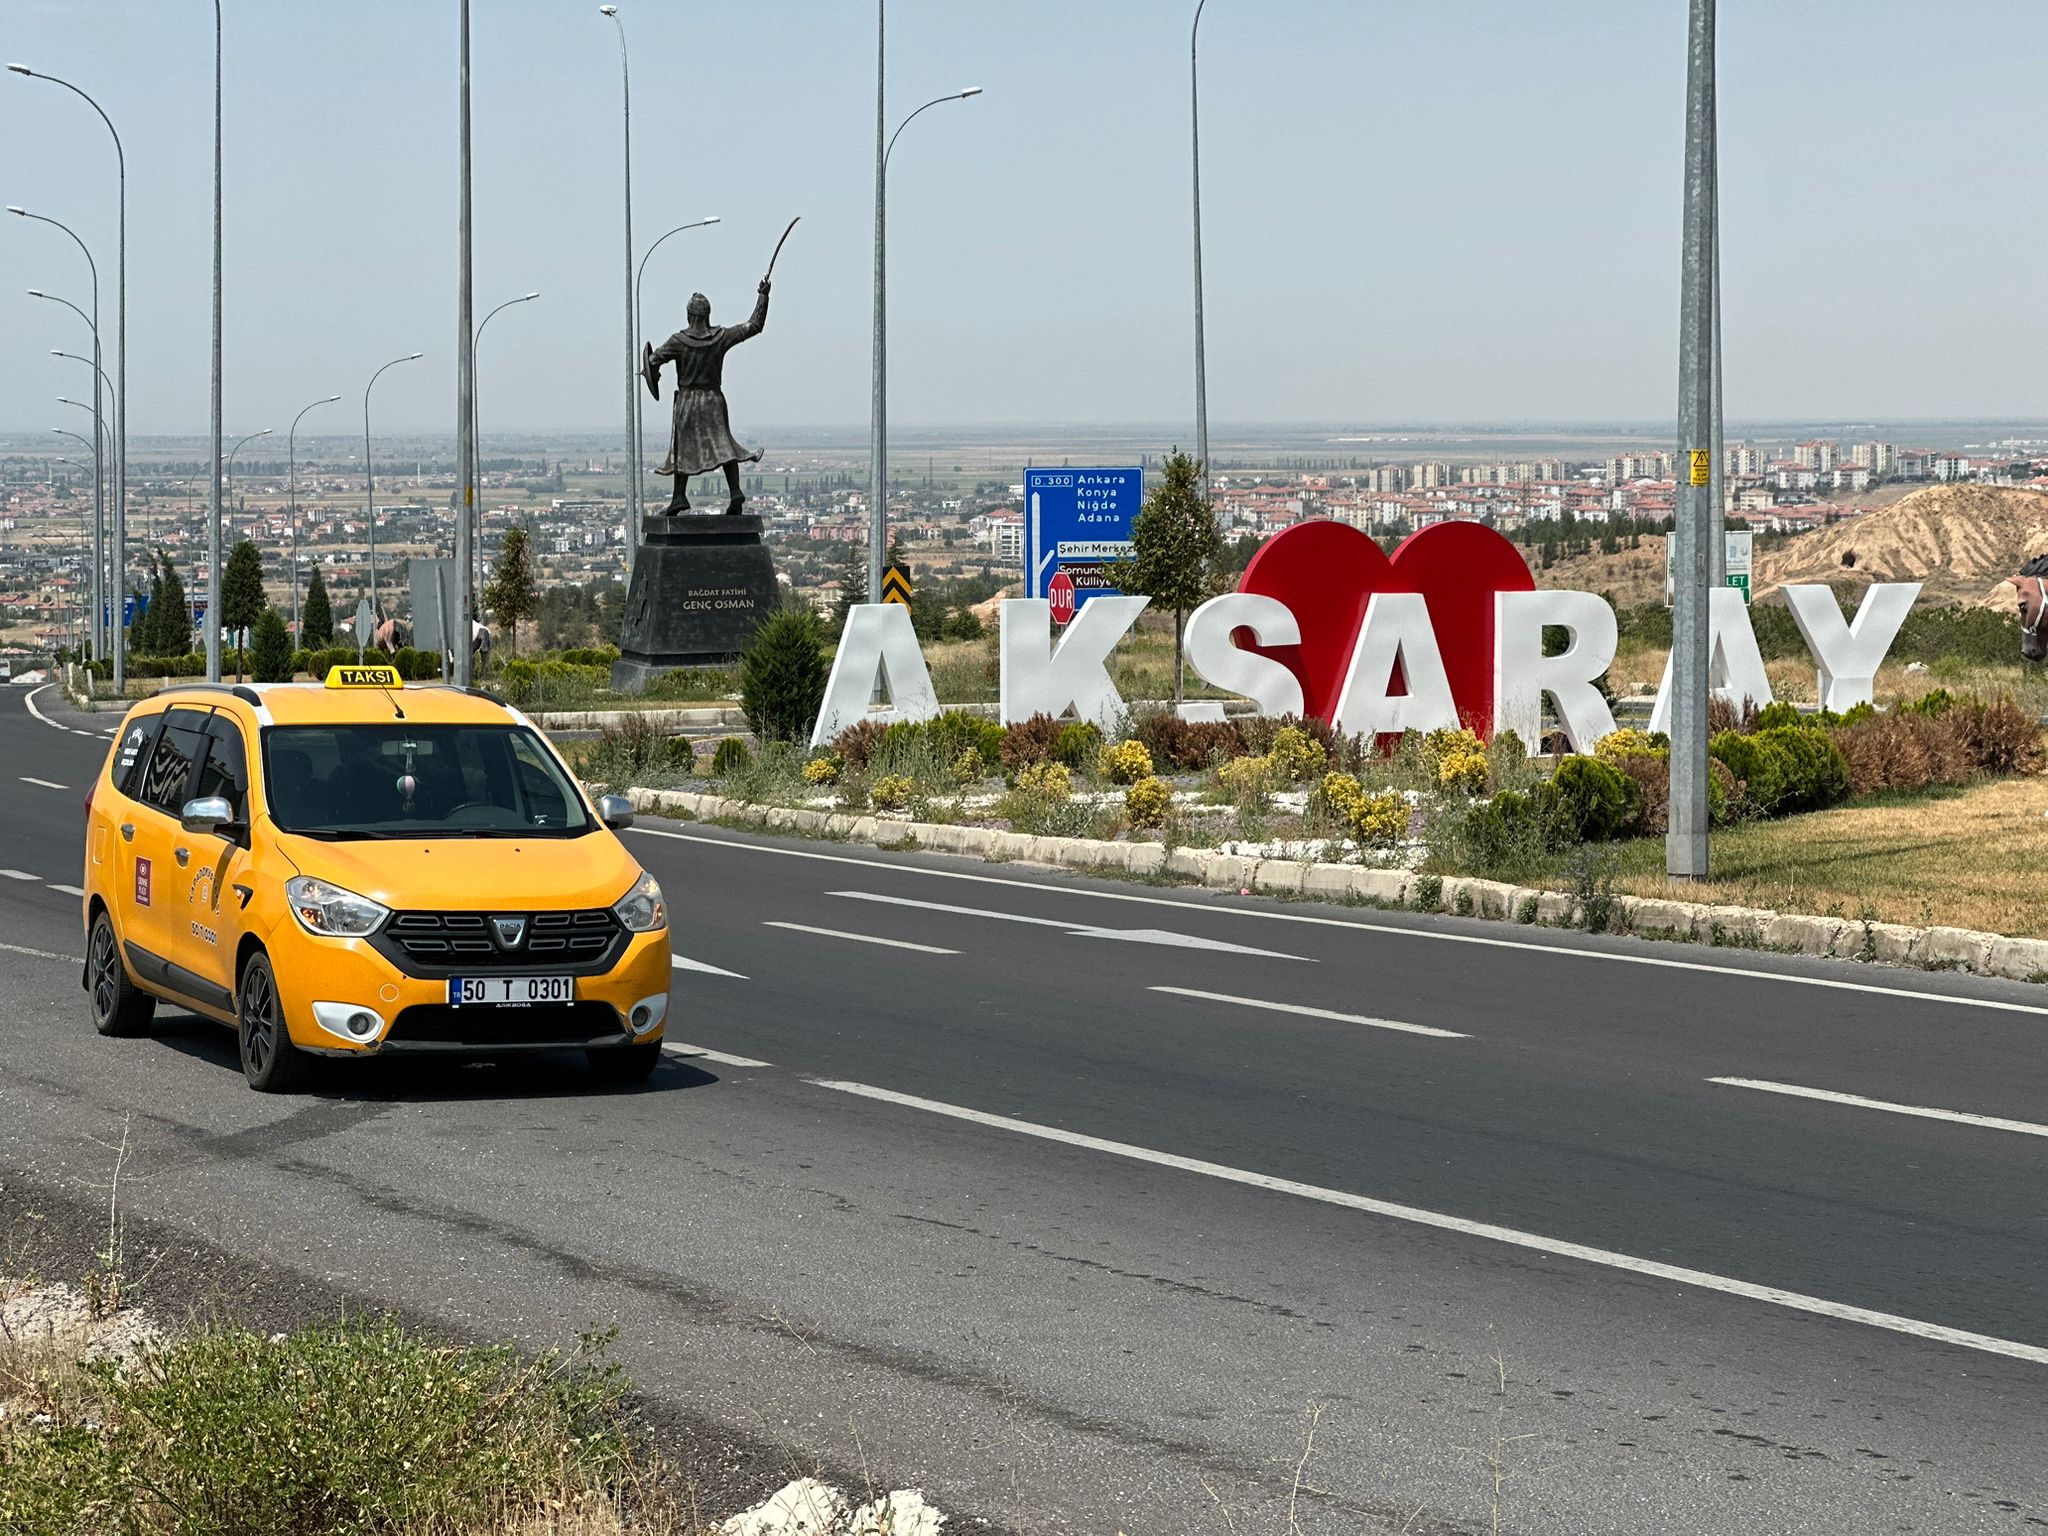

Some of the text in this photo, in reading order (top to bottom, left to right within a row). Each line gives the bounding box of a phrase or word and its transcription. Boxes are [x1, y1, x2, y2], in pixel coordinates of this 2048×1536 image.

[1078, 474, 1125, 484] Ankara
[1077, 487, 1117, 499] Konya
[1077, 500, 1117, 512] Niğde
[1078, 512, 1120, 523] Adana
[1059, 543, 1089, 554] Şehir
[1726, 575, 1745, 586] LET
[688, 586, 747, 597] BAĞDAT FATİHİ
[1050, 588, 1073, 608] DUR
[683, 599, 755, 611] GENÇ OSMAN
[810, 583, 1923, 757] AKSARAY
[463, 979, 485, 1001] 50
[502, 979, 513, 1000] T
[528, 978, 569, 999] 0301
